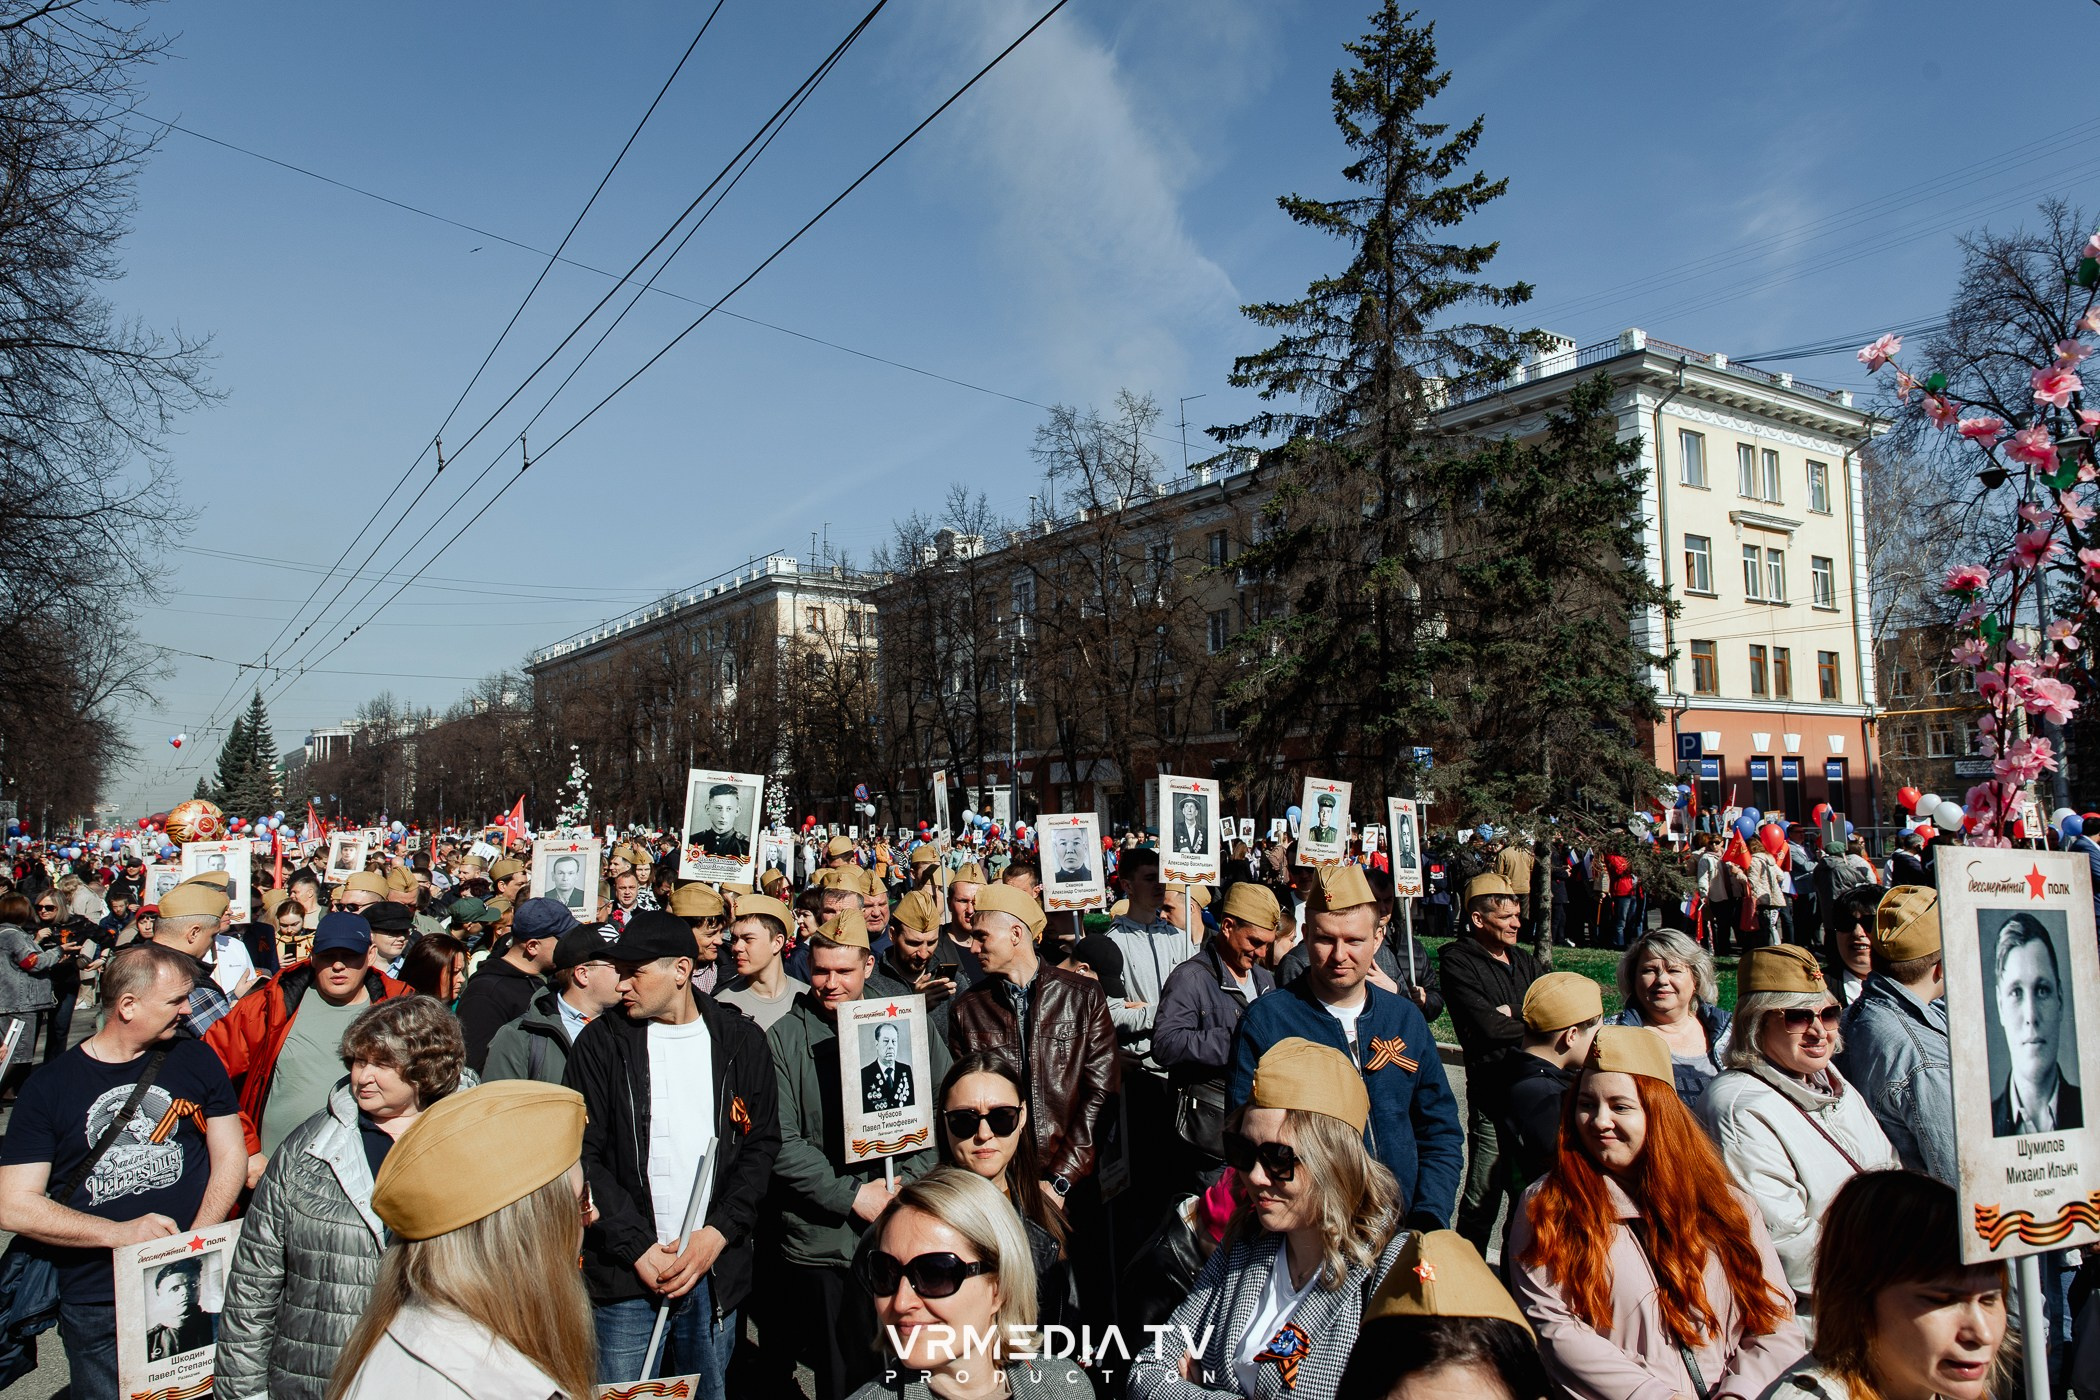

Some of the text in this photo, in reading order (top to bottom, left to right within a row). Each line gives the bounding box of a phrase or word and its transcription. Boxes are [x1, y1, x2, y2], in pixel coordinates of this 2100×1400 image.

[1682, 735, 1696, 758] P
[877, 1110, 903, 1121] Чубасов
[862, 1117, 918, 1133] Павел Тимофеевич
[2016, 1138, 2066, 1160] Шумилов
[2006, 1161, 2079, 1185] Михаил Ильич
[171, 1349, 206, 1365] Шкодин
[148, 1369, 176, 1383] Павел
